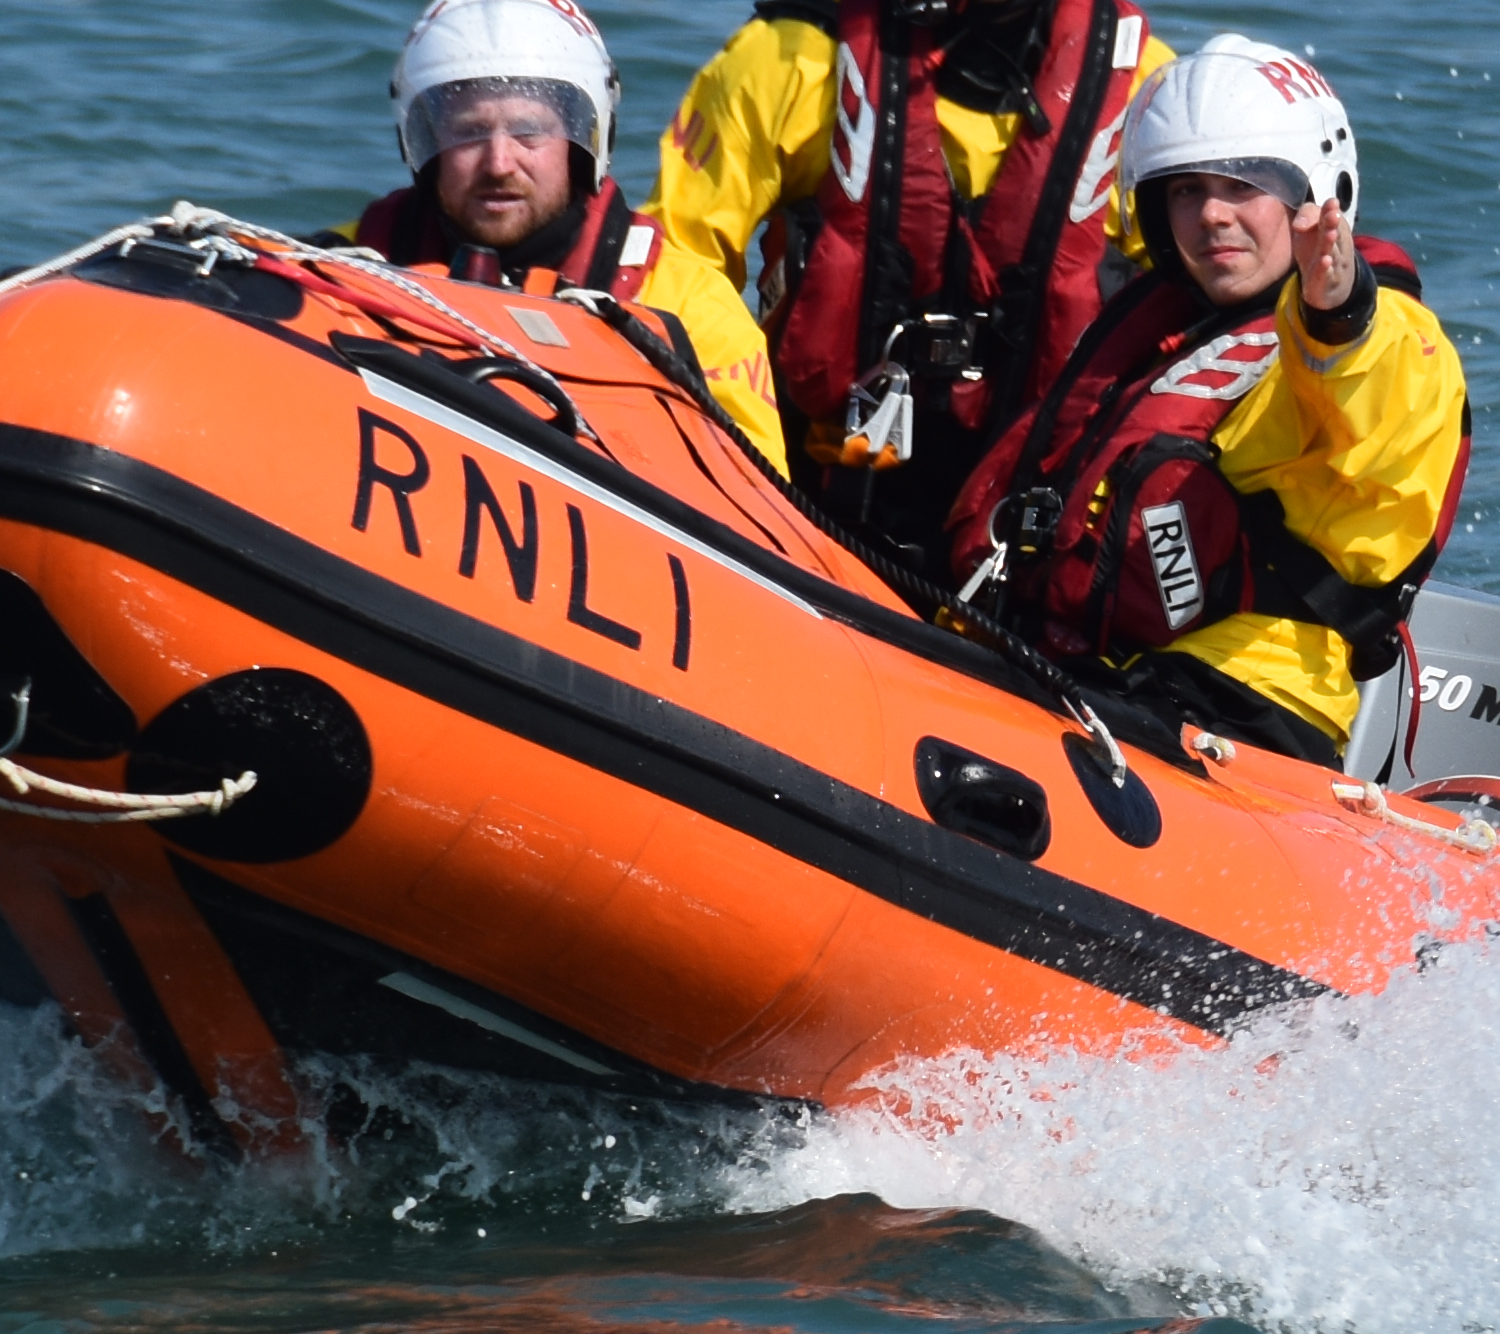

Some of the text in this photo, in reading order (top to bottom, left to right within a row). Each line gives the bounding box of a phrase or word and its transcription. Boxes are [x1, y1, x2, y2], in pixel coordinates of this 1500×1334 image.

[351, 405, 692, 672] RNLI
[1149, 519, 1200, 613] RNLI
[1407, 665, 1473, 711] 50
